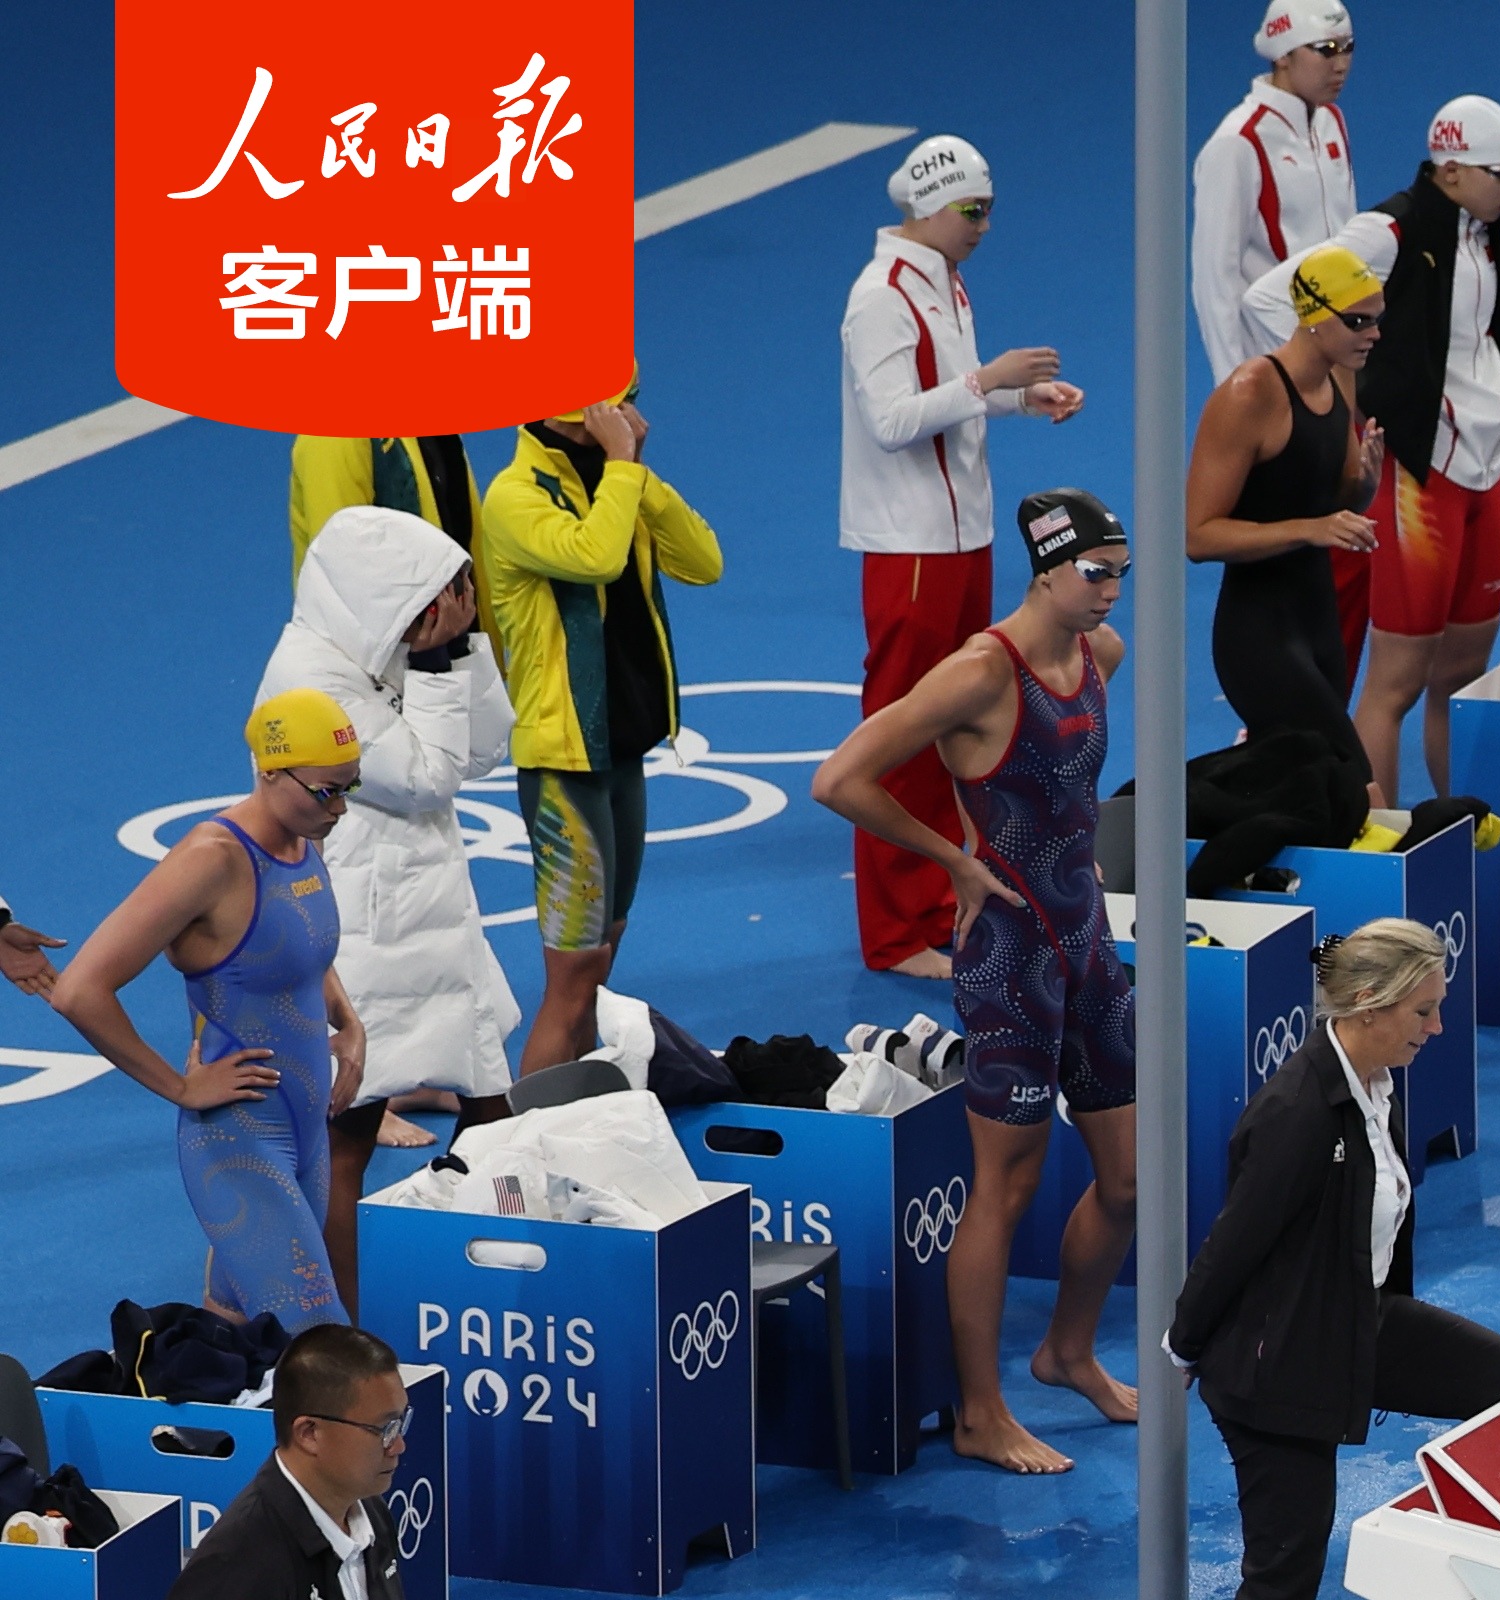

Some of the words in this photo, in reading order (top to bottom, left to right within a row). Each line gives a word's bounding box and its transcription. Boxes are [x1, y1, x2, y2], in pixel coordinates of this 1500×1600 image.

[911, 150, 957, 181] CHN
[265, 743, 292, 756] SWE
[1011, 1085, 1051, 1103] USA
[301, 1292, 333, 1312] SWE
[445, 1368, 597, 1427] 024
